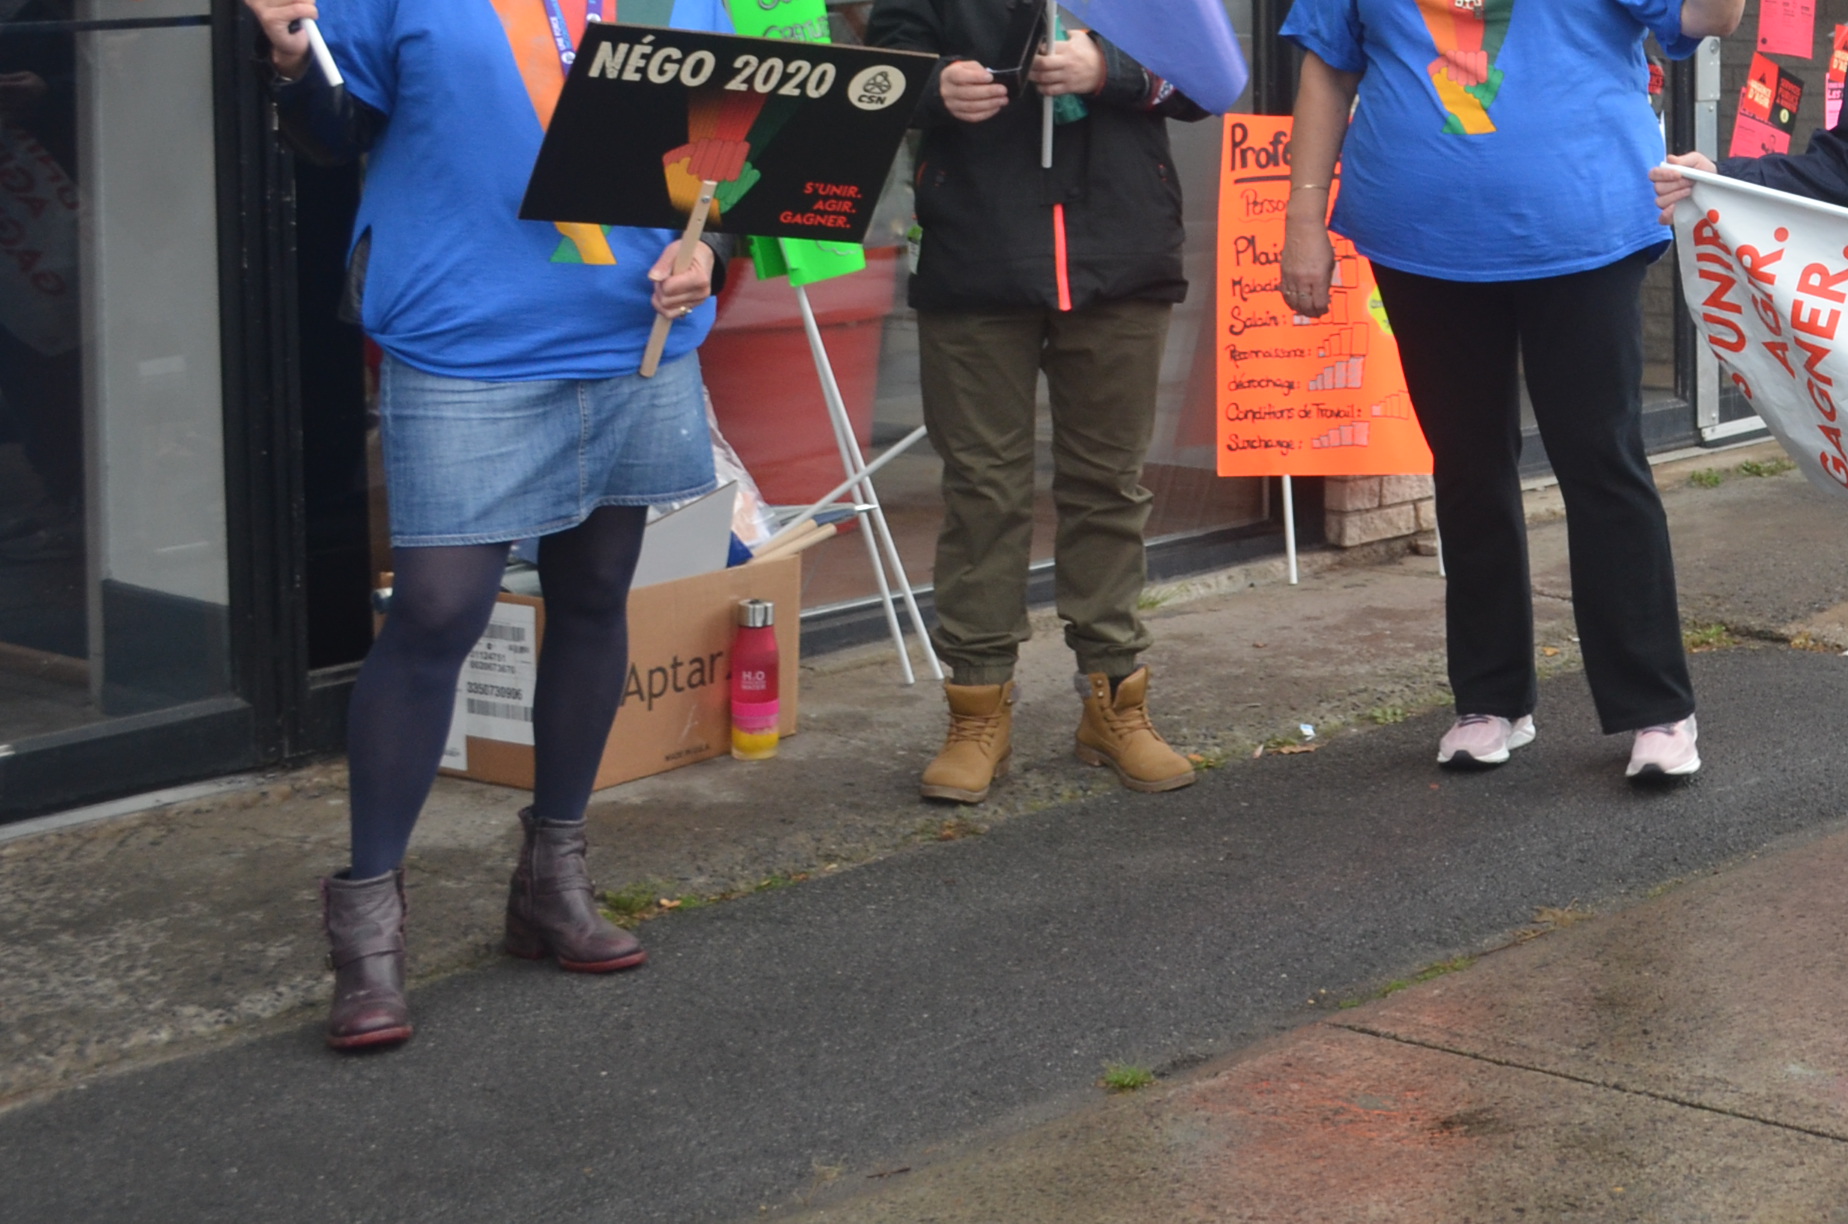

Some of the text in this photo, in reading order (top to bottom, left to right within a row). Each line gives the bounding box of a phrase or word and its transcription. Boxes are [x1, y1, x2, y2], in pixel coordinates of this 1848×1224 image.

[588, 34, 838, 99] NÉGO 2020
[857, 94, 887, 106] CSN
[803, 181, 863, 199] S'UNIR.
[812, 198, 857, 214] AGIR.
[1240, 188, 1286, 217] Perso
[779, 210, 852, 229] GAGNER.
[1734, 226, 1790, 380] AGIR.
[1226, 402, 1294, 424] Conditions
[620, 649, 723, 712] Aptar
